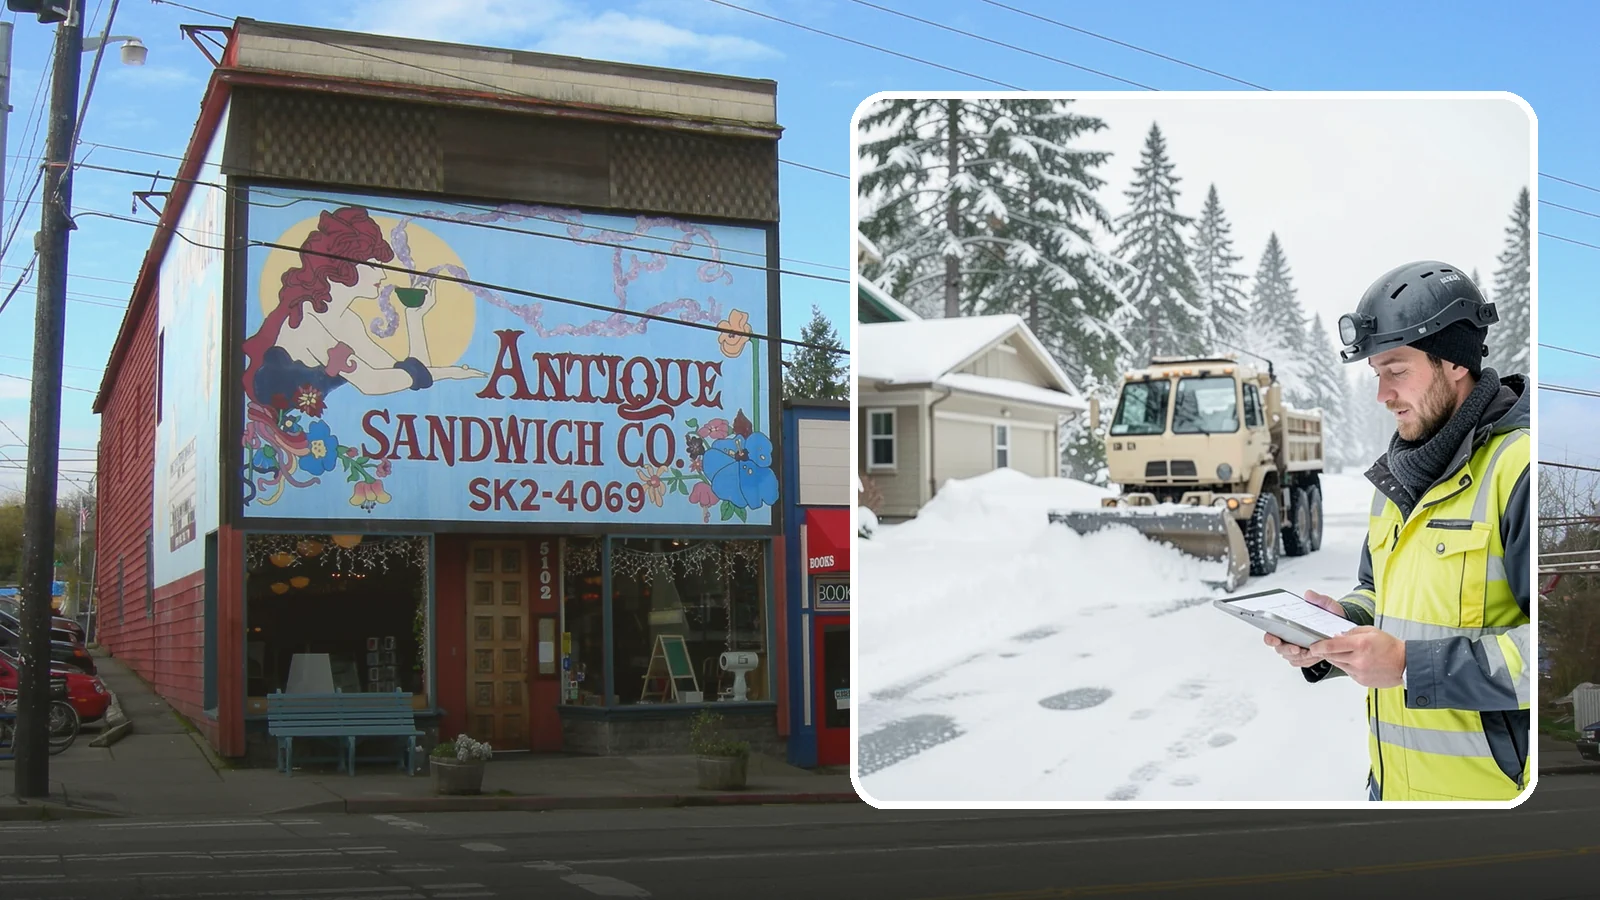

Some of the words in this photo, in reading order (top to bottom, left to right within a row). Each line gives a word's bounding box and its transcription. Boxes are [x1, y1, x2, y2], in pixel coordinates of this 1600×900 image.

[361, 408, 604, 467] SANDWICH
[617, 422, 685, 469] CO.
[468, 477, 646, 513] SK2-4069
[540, 541, 552, 600] 5102
[809, 555, 834, 569] BOOKS
